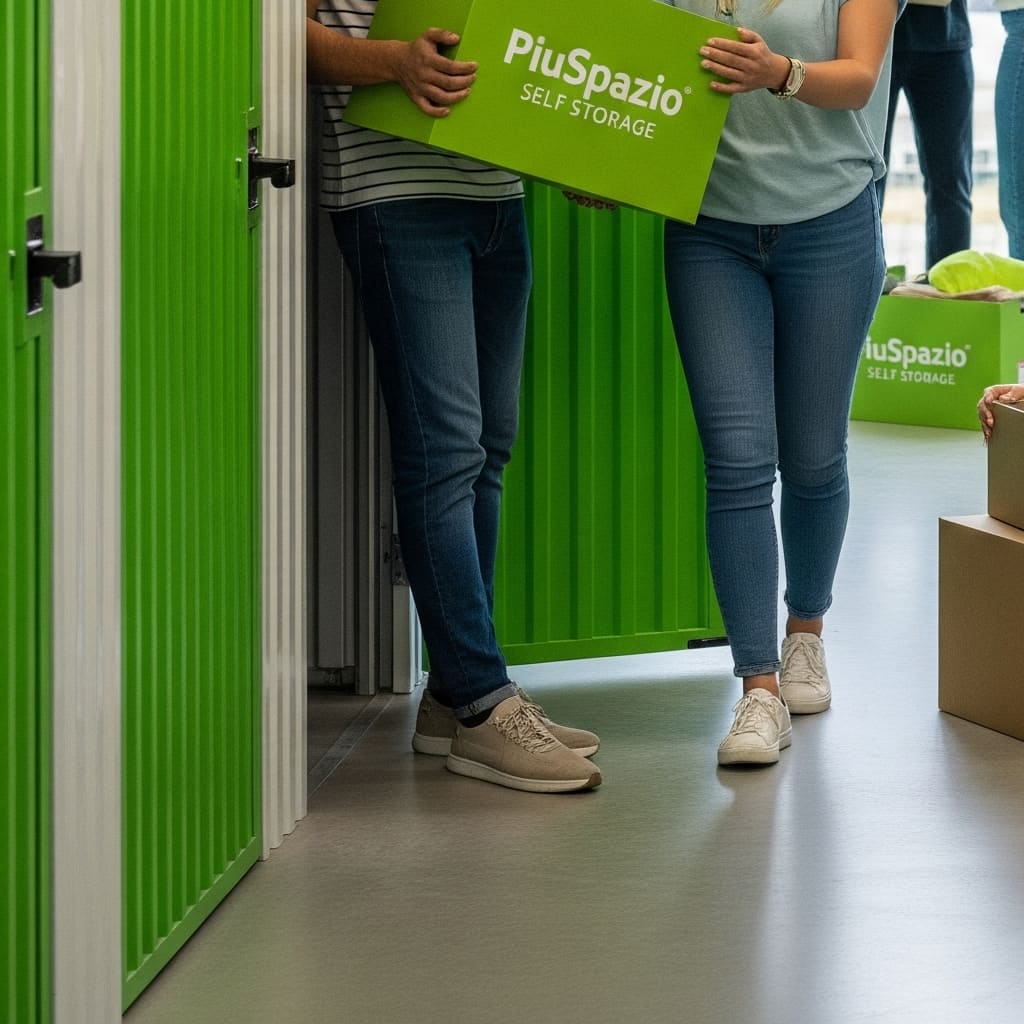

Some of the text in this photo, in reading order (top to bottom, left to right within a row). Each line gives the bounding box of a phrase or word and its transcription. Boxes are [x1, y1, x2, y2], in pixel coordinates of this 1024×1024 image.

[520, 82, 658, 140] SELF STORAGE
[865, 336, 968, 370] iuSpazio
